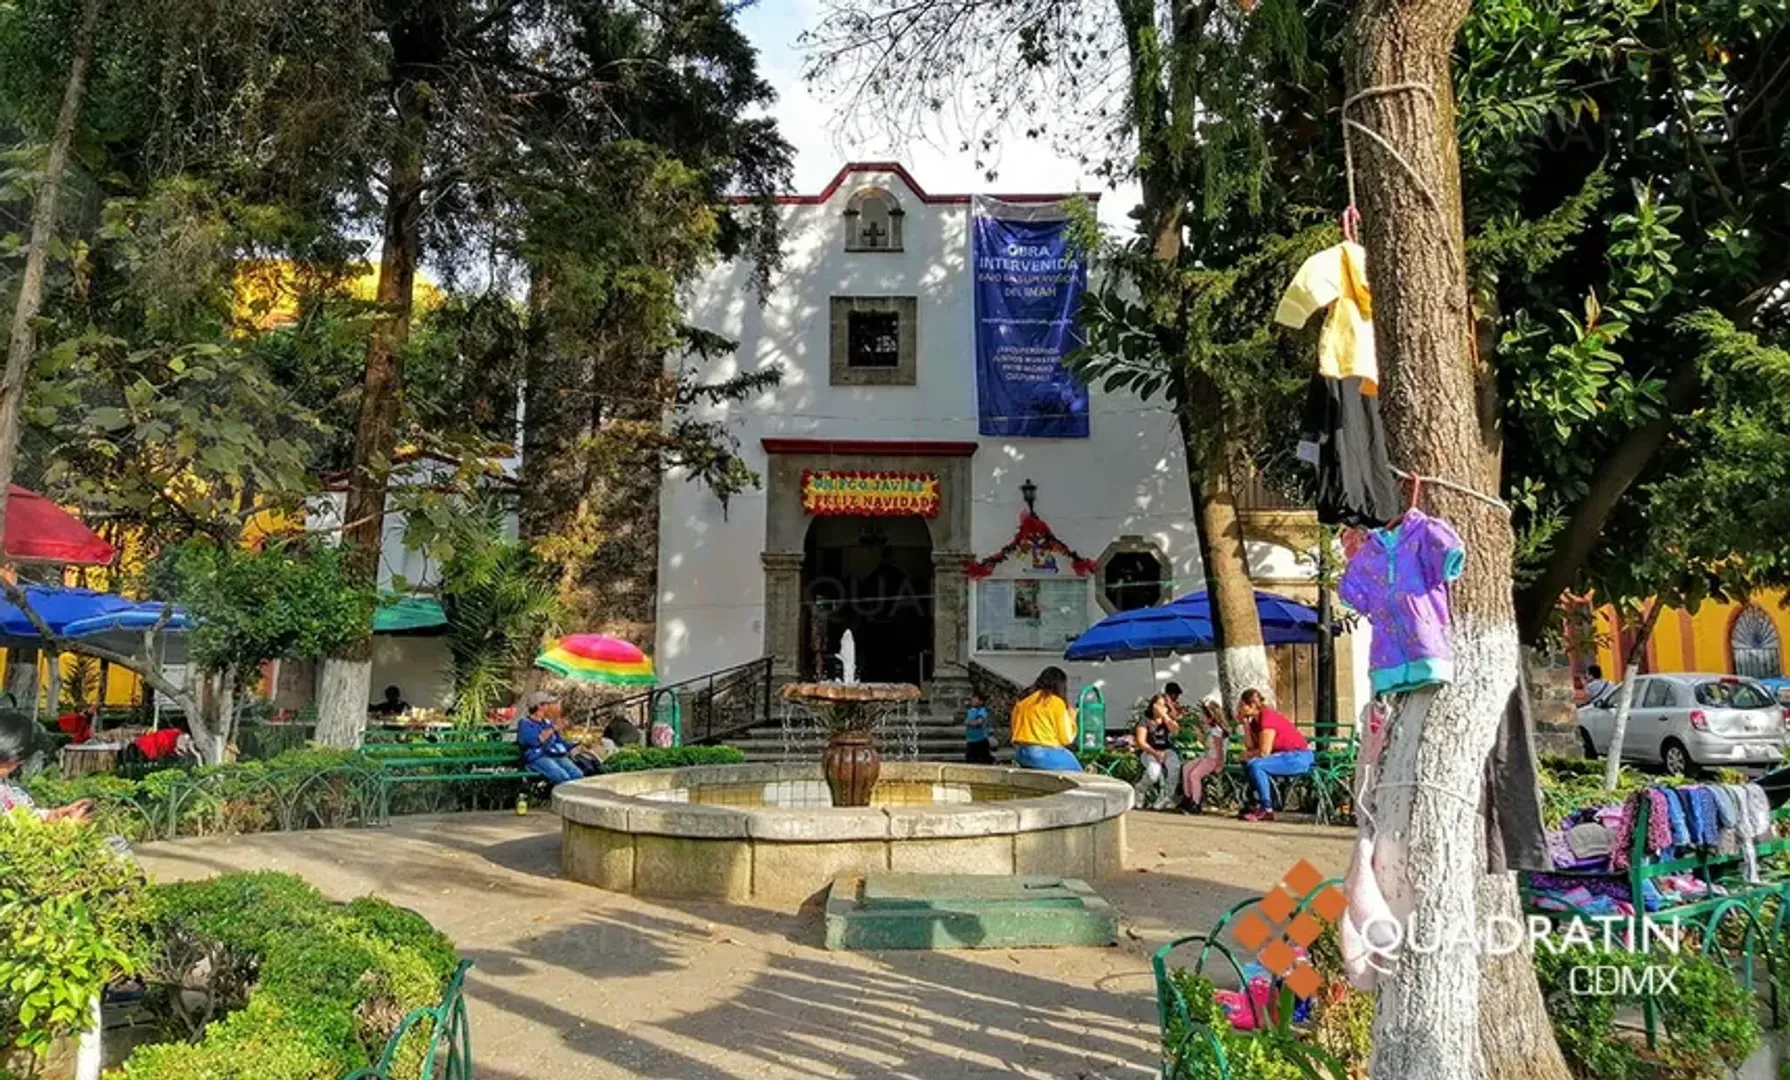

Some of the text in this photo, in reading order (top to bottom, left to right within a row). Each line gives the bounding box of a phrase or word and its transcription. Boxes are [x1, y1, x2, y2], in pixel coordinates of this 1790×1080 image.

[1007, 243, 1050, 257] OBRA
[979, 256, 1079, 272] INTERVENIDA
[1004, 286, 1057, 297] DEL INAH
[873, 479, 925, 492] JAVIER
[814, 494, 932, 508] FELIZ NAVIDAD
